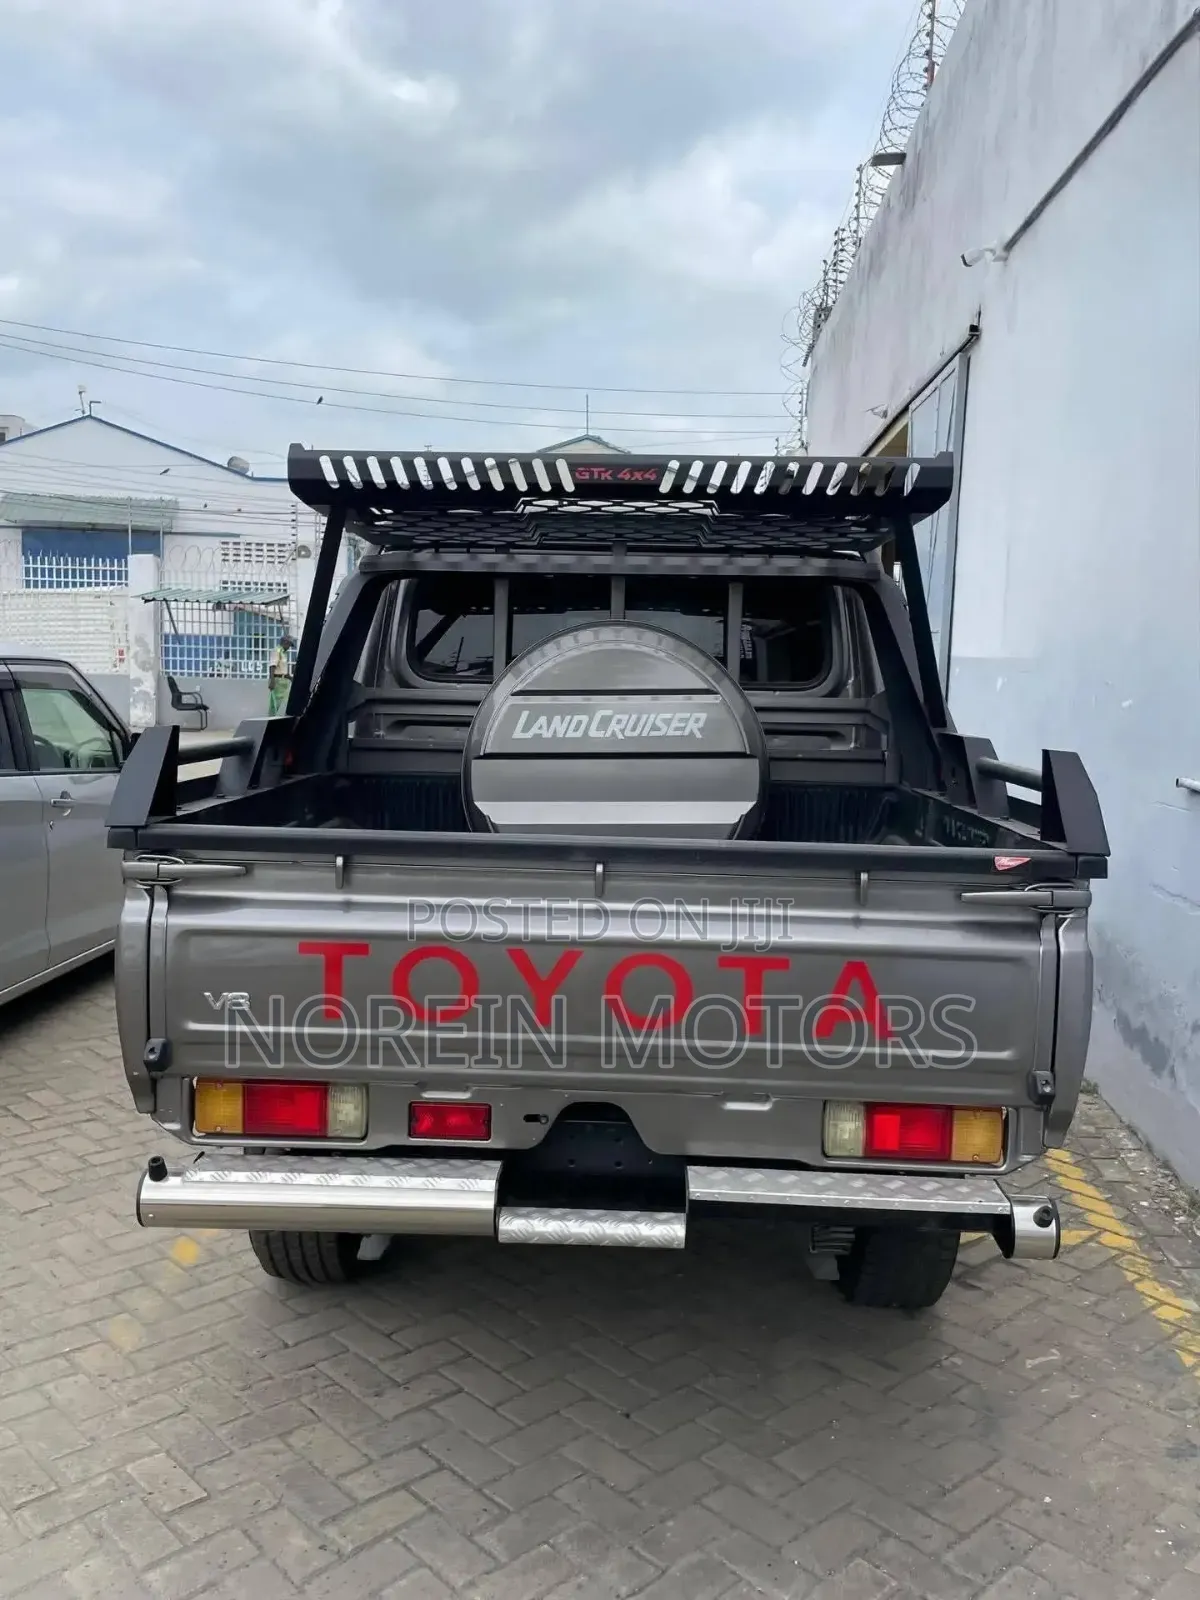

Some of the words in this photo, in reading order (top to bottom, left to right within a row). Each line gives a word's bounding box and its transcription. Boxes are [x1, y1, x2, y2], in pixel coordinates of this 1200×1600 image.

[617, 467, 658, 480] 4x4
[588, 709, 708, 740] CRUISER
[203, 991, 251, 1010] V8
[298, 940, 896, 1040] TOYOTA
